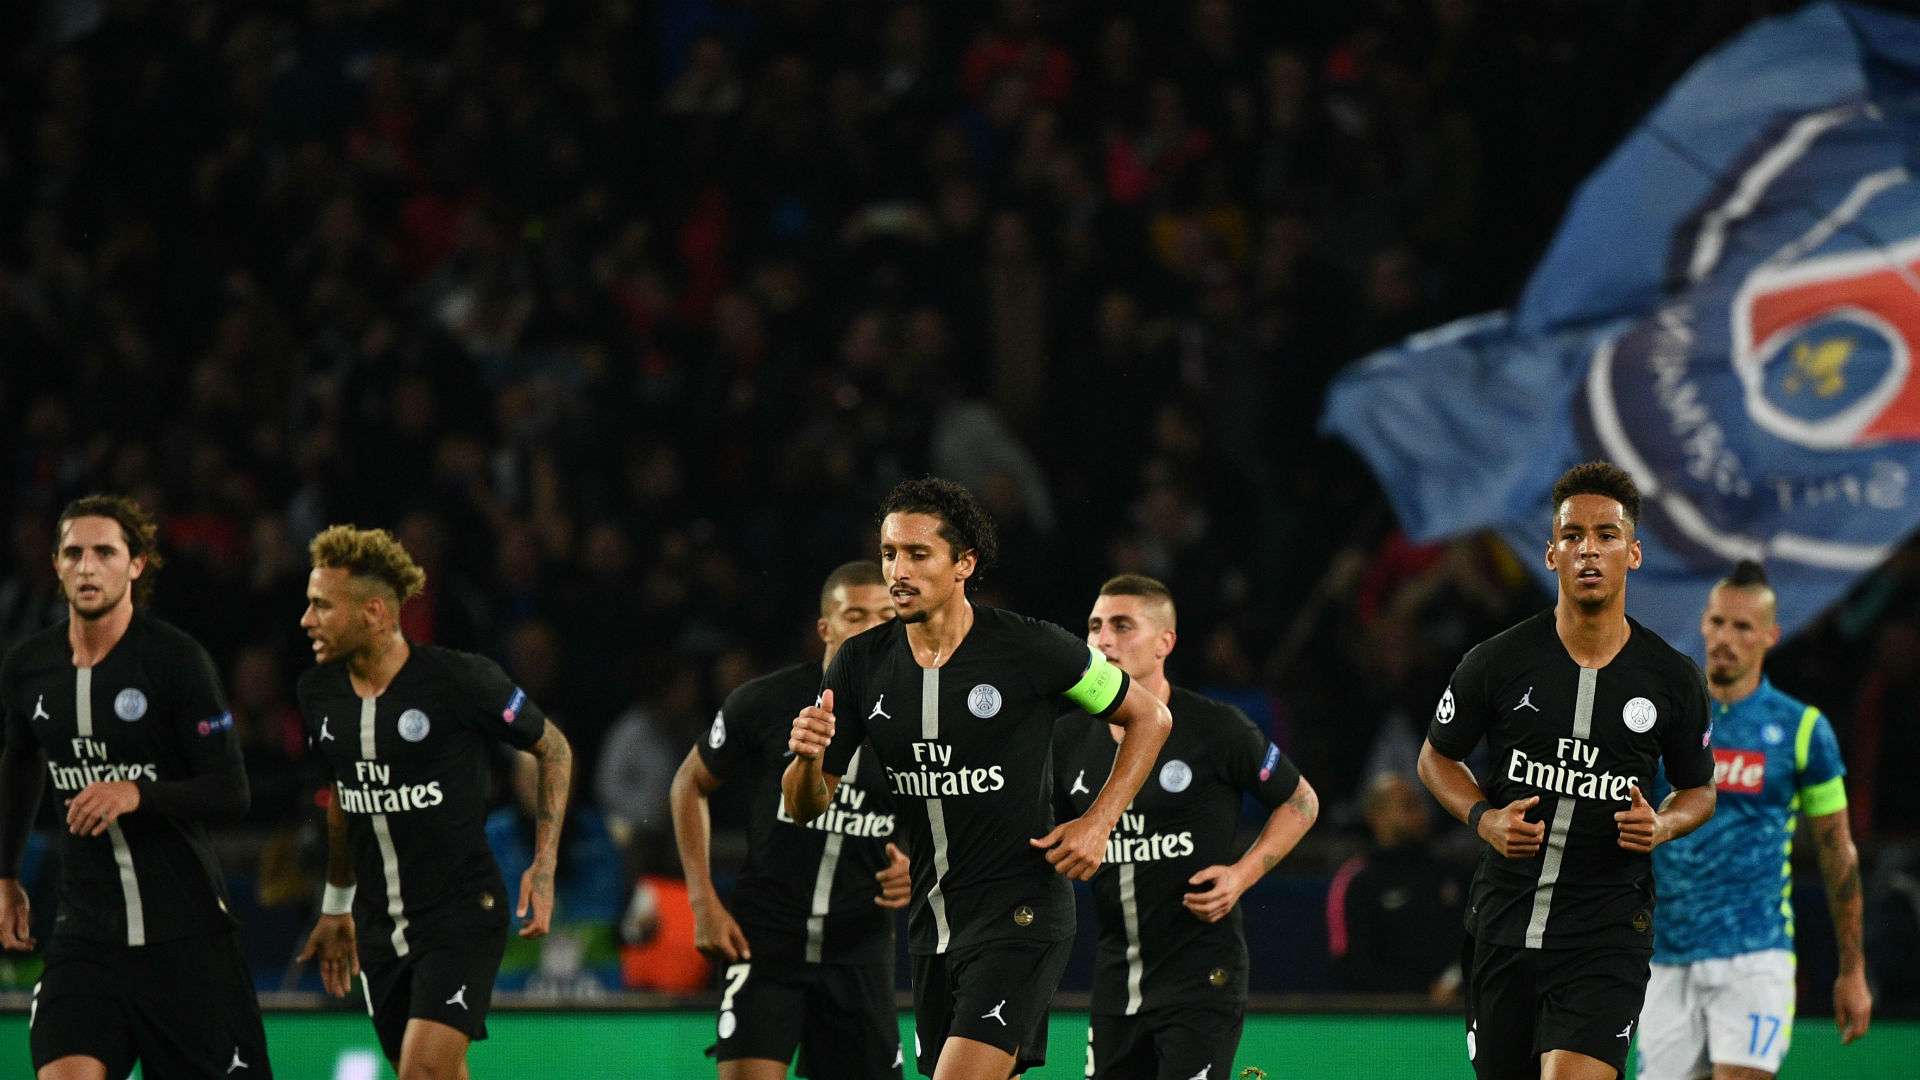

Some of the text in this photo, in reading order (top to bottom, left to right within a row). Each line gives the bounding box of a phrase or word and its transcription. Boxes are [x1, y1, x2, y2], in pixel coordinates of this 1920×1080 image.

[72, 738, 107, 761] Fly
[911, 742, 952, 767] Fly
[1557, 738, 1600, 768] Fly
[355, 761, 390, 786] Fly
[1508, 748, 1639, 802] Emirates
[1713, 755, 1765, 787] ete
[837, 783, 866, 810] ly
[777, 793, 896, 837] irates
[1112, 812, 1145, 835] ly
[721, 963, 752, 1012] 7
[1747, 1012, 1781, 1058] 17
